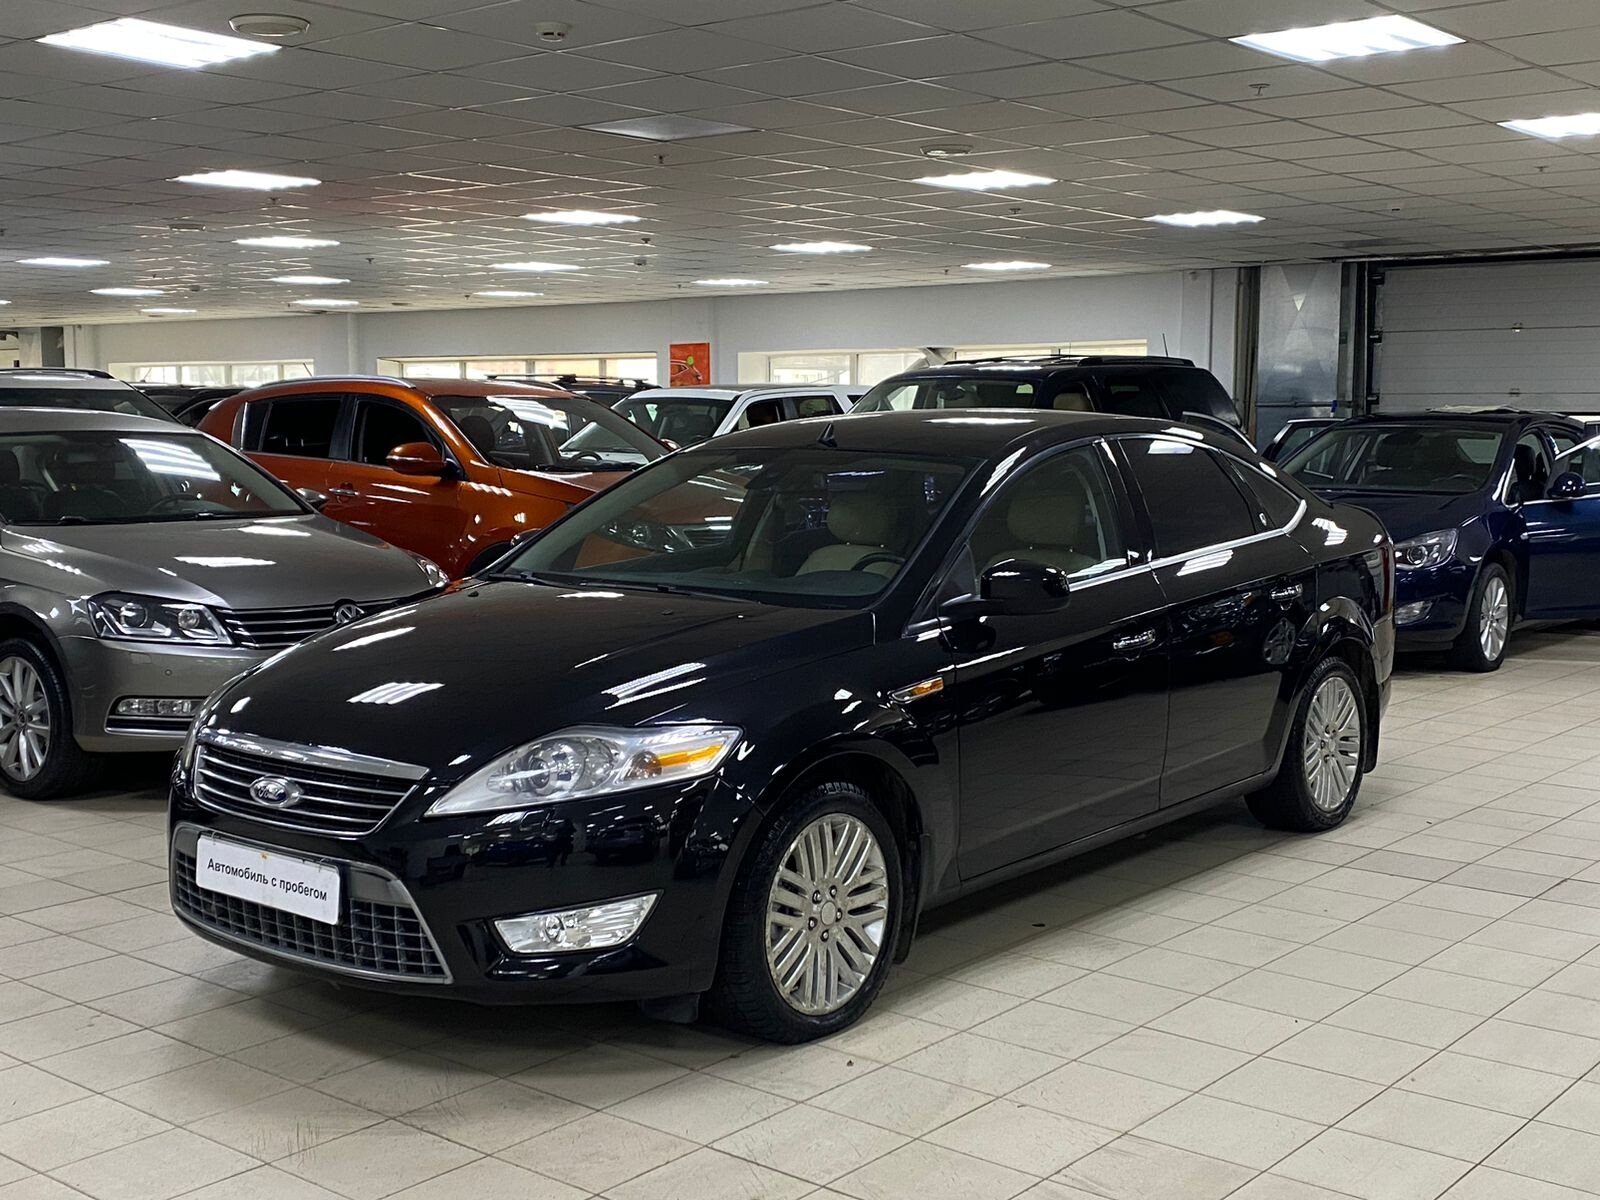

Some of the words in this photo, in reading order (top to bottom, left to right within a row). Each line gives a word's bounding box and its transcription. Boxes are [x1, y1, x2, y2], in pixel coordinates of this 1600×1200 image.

[207, 858, 269, 885] Автомобиль
[271, 876, 277, 887] с
[279, 879, 327, 901] пробегом
